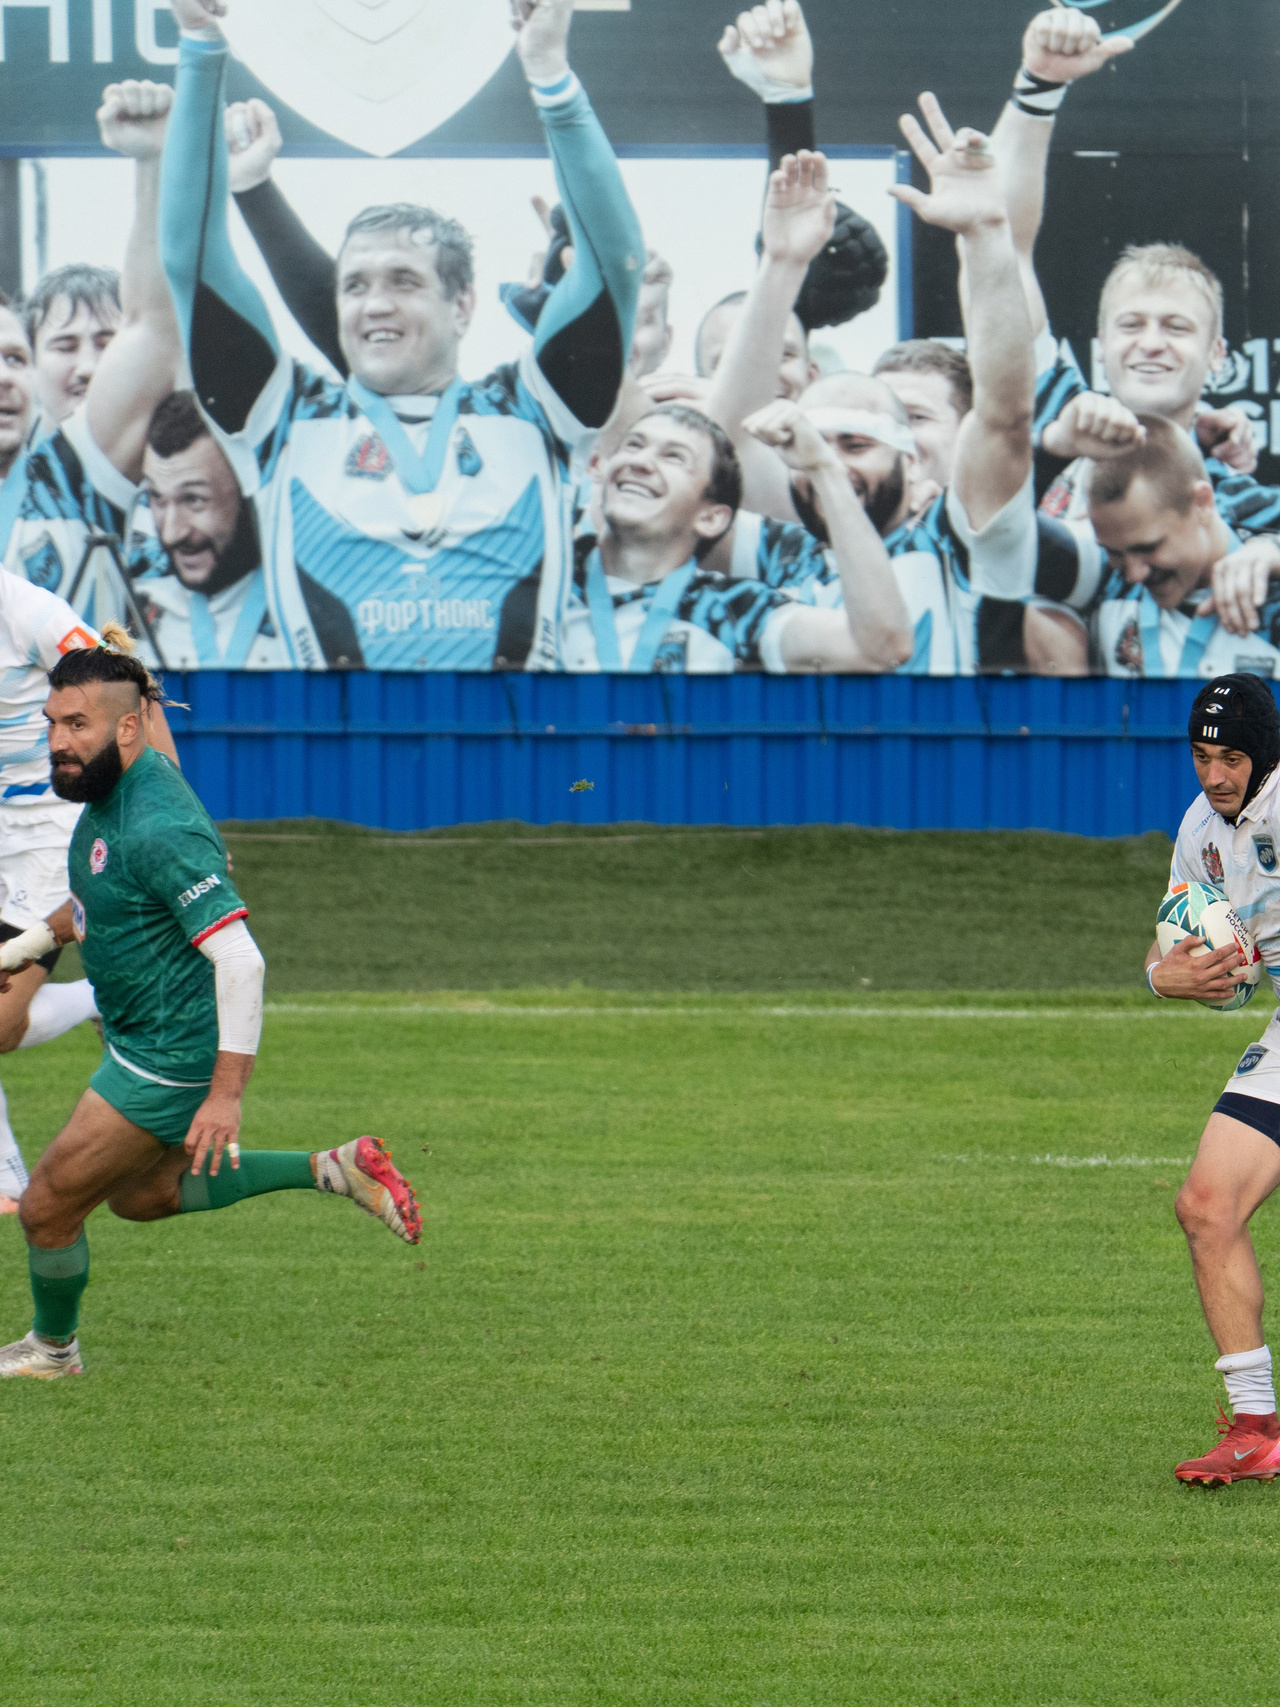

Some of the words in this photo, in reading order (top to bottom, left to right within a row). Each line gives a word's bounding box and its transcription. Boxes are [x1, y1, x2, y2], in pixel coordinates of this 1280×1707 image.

[357, 598, 496, 635] ФОРТНОКС
[186, 873, 222, 900] USN
[1225, 913, 1249, 948] РОССИИ
[1229, 908, 1249, 935] РЕГБИ
